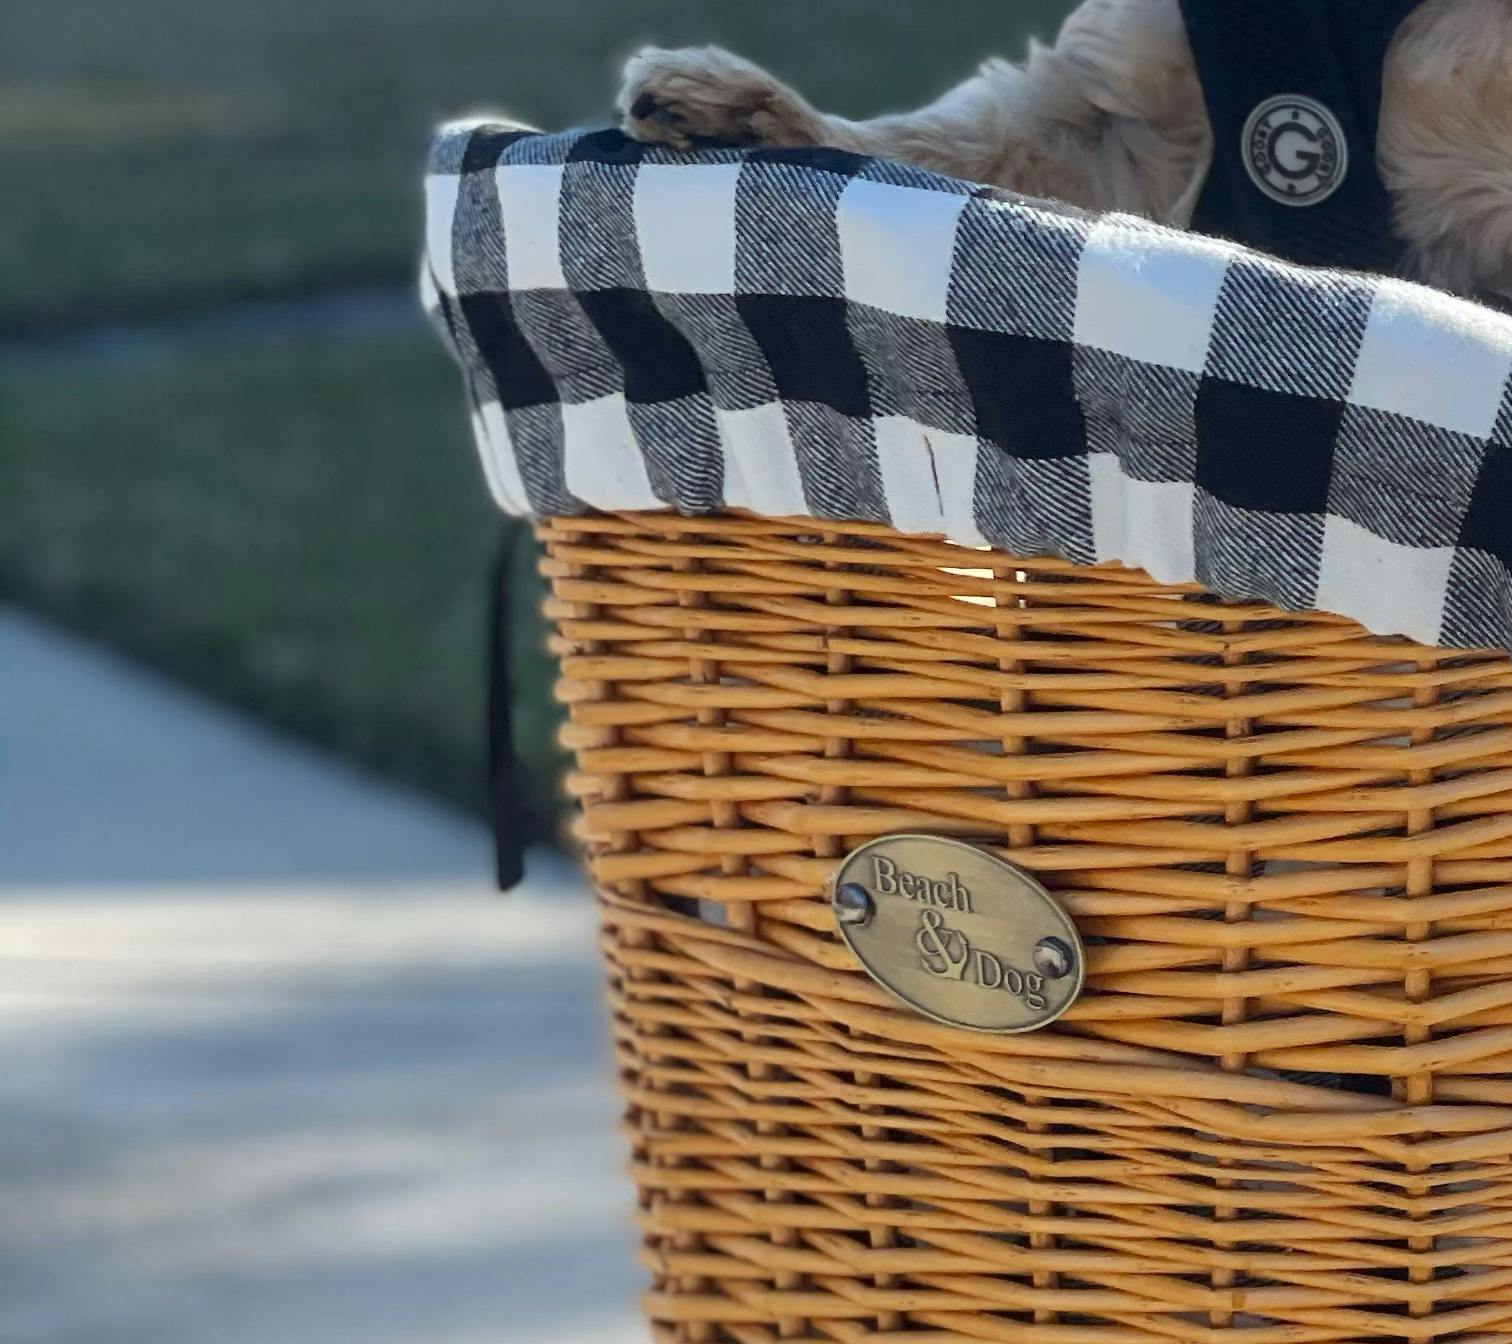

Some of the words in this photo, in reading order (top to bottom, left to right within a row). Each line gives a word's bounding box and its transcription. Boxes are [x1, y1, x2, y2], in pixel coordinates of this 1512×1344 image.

[1268, 121, 1321, 180] G
[872, 855, 973, 913] Beach
[916, 909, 968, 980] &
[975, 950, 1045, 1010] Dog
